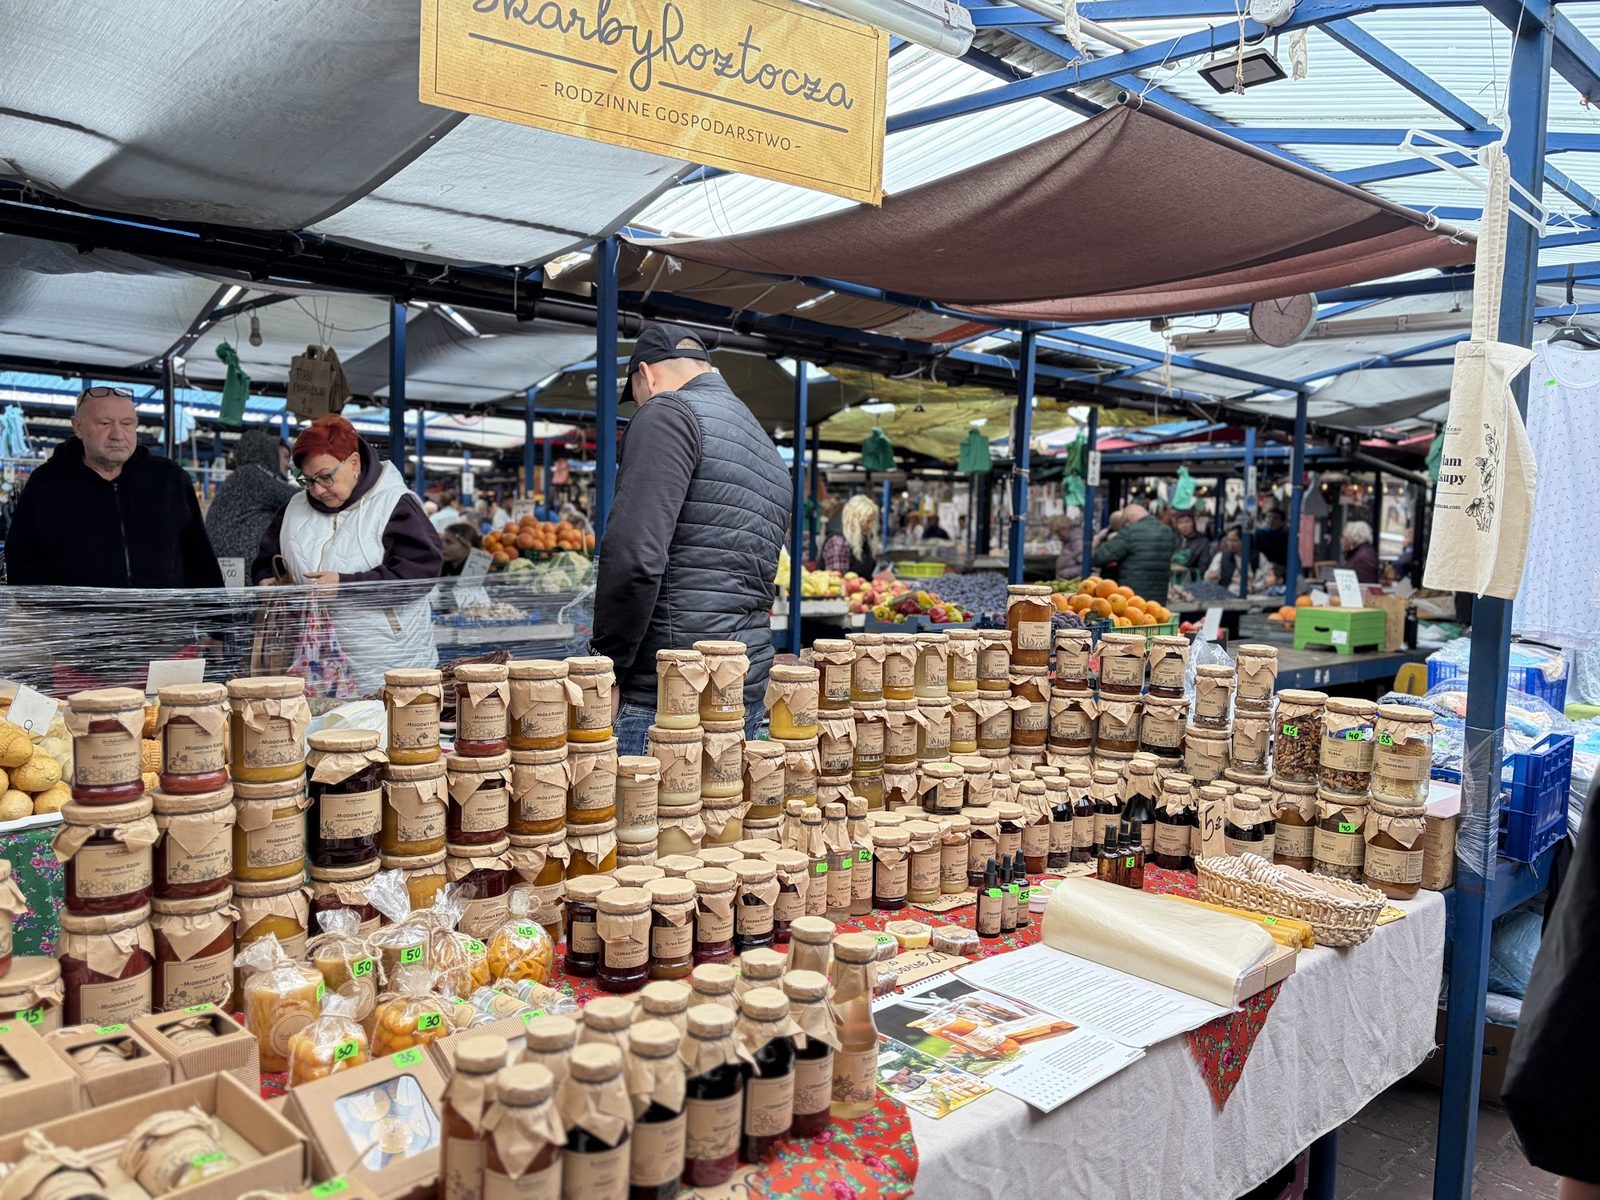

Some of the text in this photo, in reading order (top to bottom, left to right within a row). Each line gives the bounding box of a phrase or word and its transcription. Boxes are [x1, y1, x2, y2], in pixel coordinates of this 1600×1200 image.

[555, 81, 792, 152] RODZINNE GOSPODARSTWO
[1348, 732, 1359, 740] 40
[1379, 735, 1390, 744] 55
[1340, 824, 1352, 832] 40
[861, 851, 871, 860] 22
[1020, 890, 1030, 900] 55
[406, 947, 421, 960] 50
[356, 961, 372, 975] 50
[425, 1014, 440, 1028] 30
[337, 1044, 353, 1059] 30
